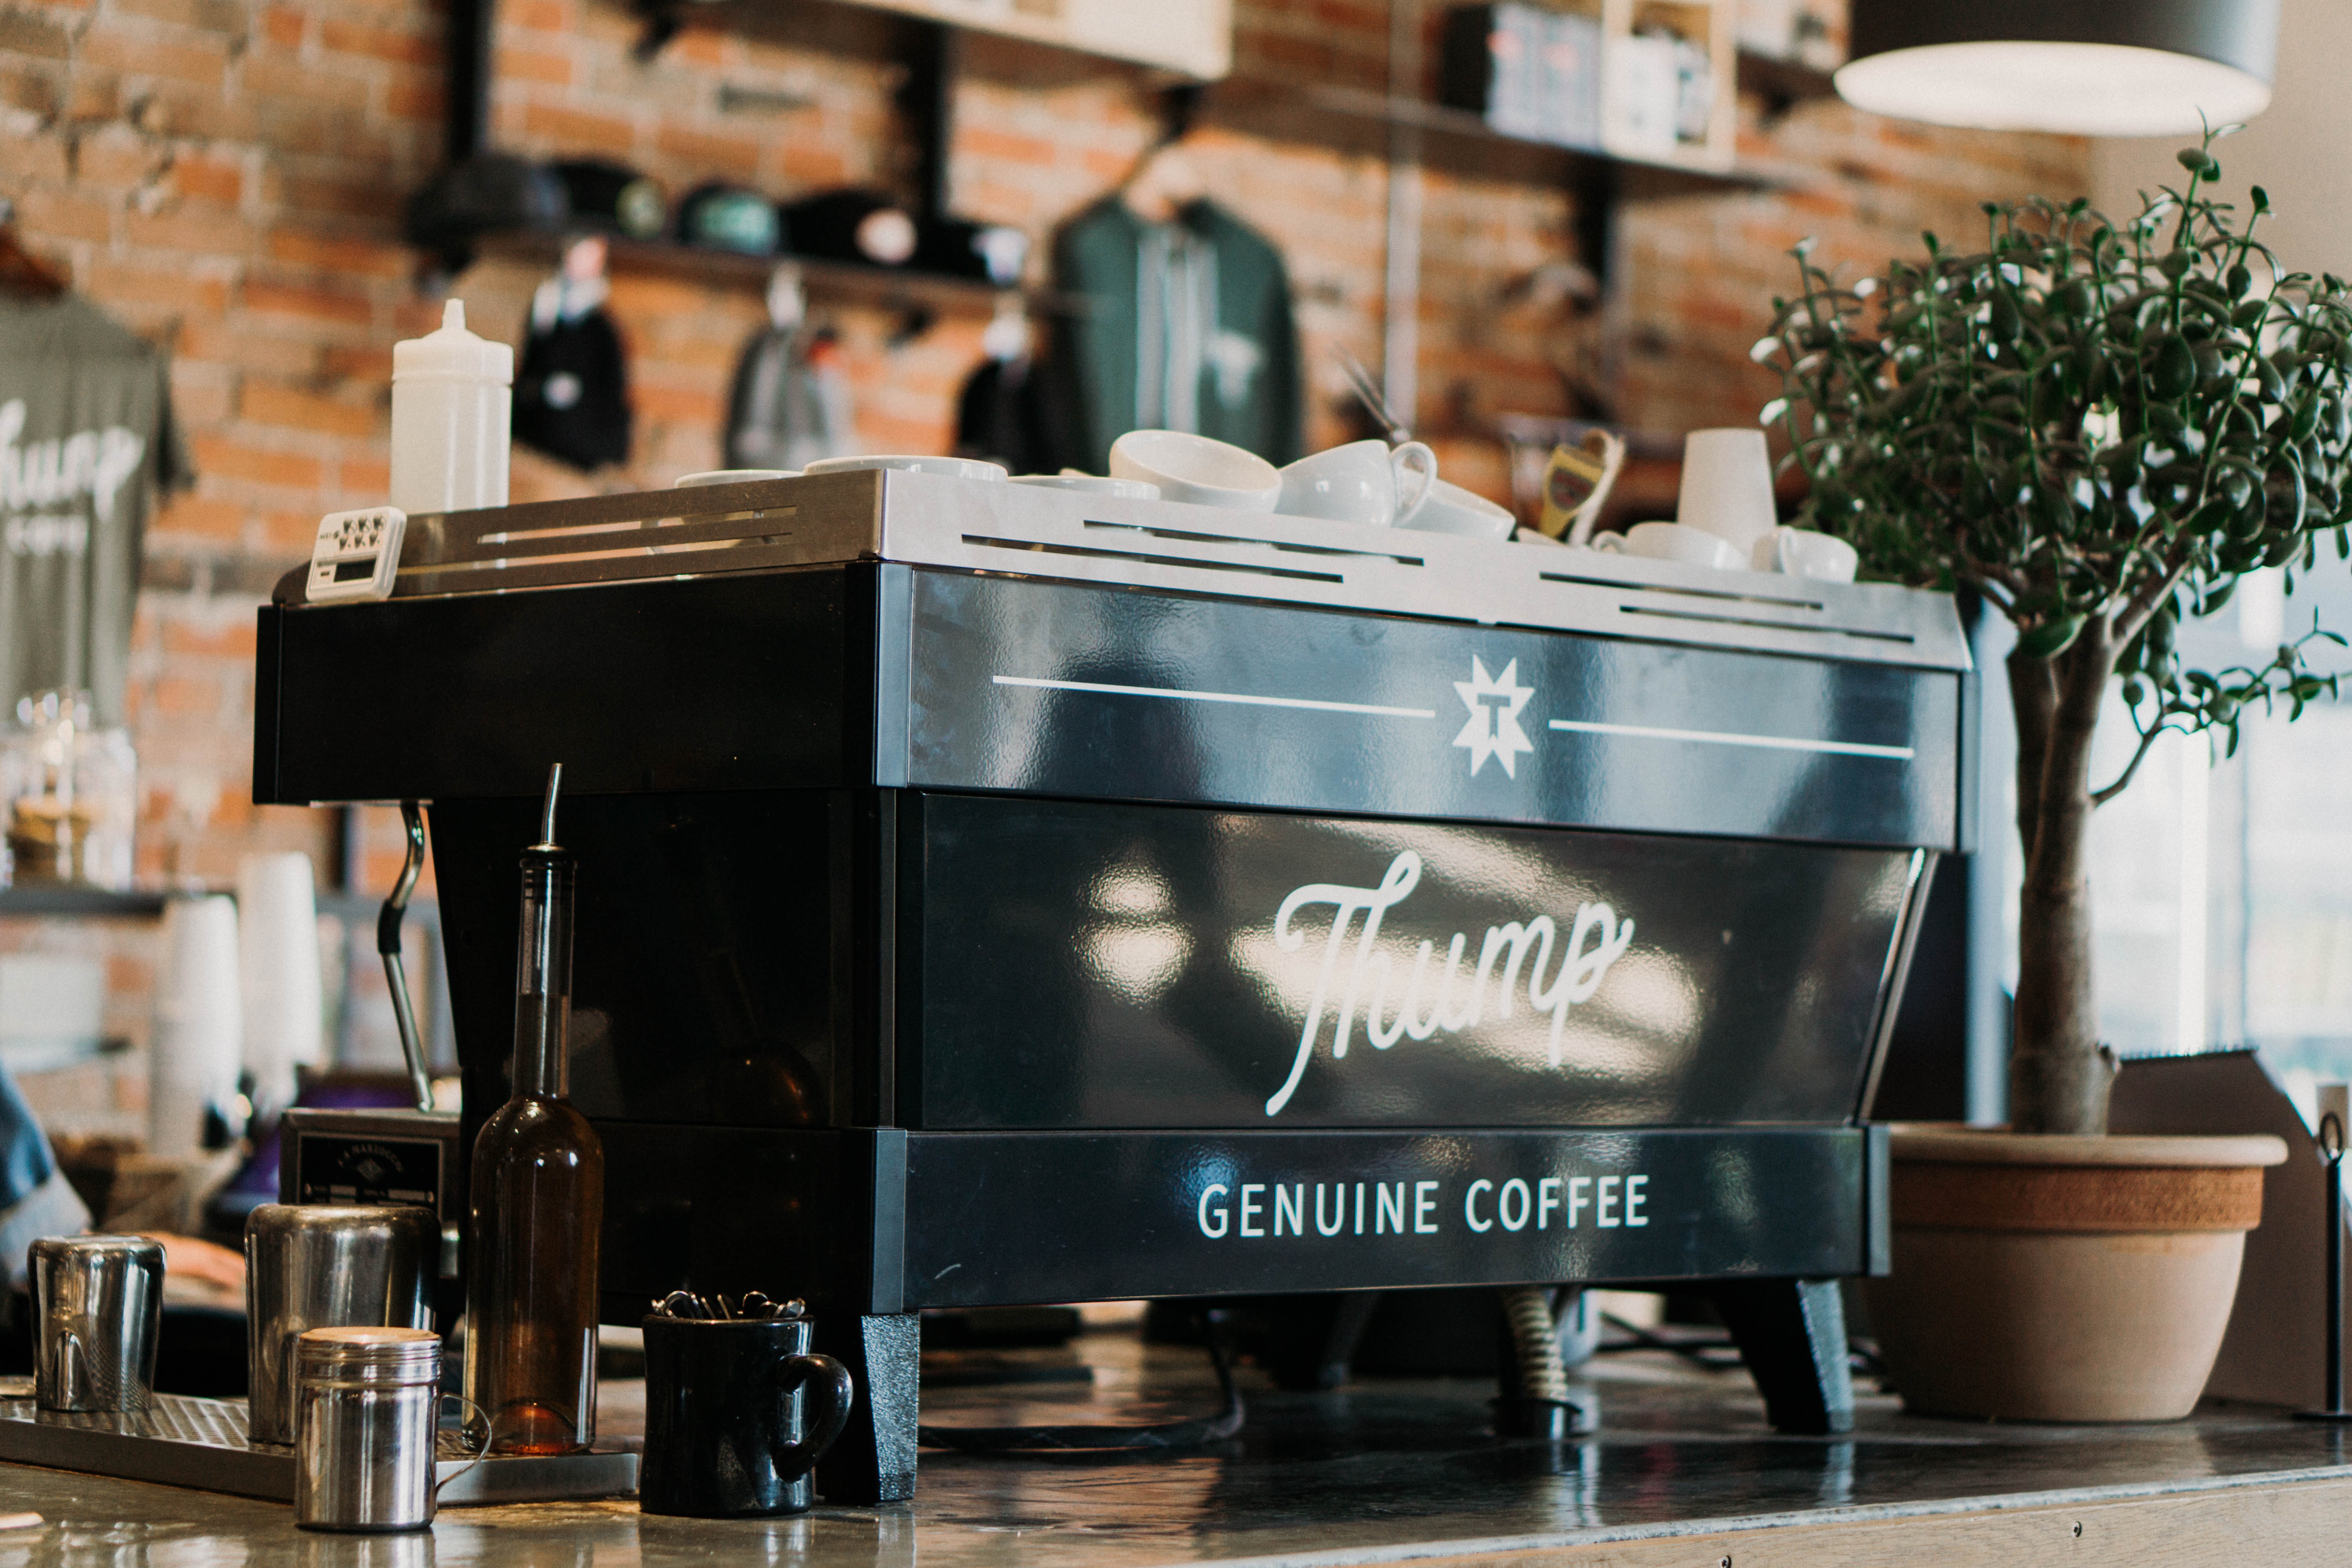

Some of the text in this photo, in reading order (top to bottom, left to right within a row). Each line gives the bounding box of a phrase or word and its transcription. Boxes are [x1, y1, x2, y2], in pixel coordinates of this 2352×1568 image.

[1265, 849, 1634, 1116] Thump
[1197, 1176, 1649, 1239] GENUINE COFFEE
